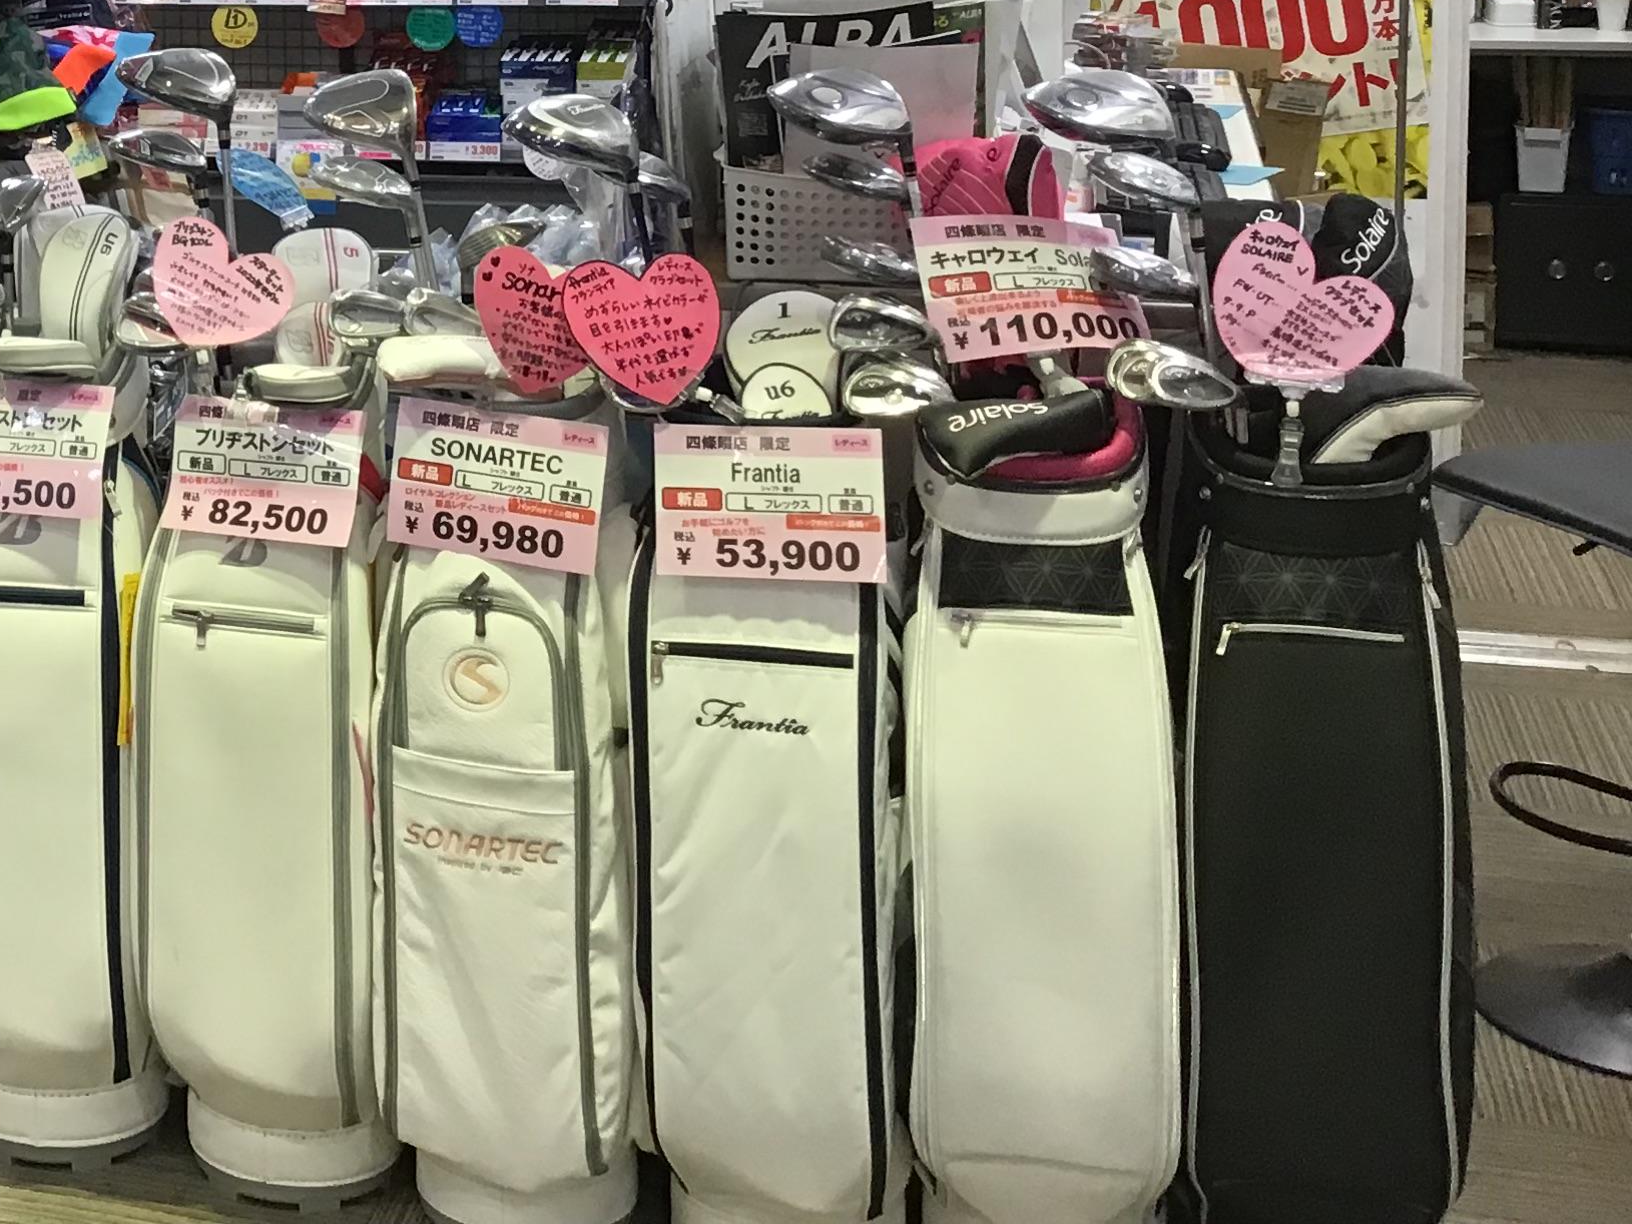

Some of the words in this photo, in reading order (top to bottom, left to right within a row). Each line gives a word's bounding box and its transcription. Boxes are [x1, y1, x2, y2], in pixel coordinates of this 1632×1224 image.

[1015, 223, 1046, 239] 限定
[1340, 207, 1390, 275] Solaire
[930, 246, 1040, 270] キャロウェイ
[1240, 243, 1296, 264] SOLAIRE
[943, 276, 978, 293] 新品
[1012, 275, 1023, 289] L
[1033, 276, 1076, 287] フレックス
[777, 302, 792, 319] 1
[954, 331, 969, 350] ¥
[979, 311, 1141, 347] 110,000
[948, 400, 1049, 433] Solaire
[195, 428, 335, 456] ブリヂストンセット
[489, 420, 520, 438] 限定
[563, 431, 595, 445] レディース
[759, 436, 791, 452] 限定
[833, 438, 869, 448] レディース
[8, 440, 46, 453] フレックス
[68, 444, 89, 457] 普通
[430, 437, 563, 475] SONARTEC
[189, 456, 214, 471] 新品
[243, 464, 251, 477] L
[259, 466, 298, 479] フレックス
[321, 469, 342, 483] 普通
[730, 462, 801, 484] Frantia
[182, 491, 200, 502] 税込
[410, 464, 440, 482] 新品
[462, 474, 471, 488] L
[491, 480, 533, 496] フレックス
[559, 489, 582, 505] 普通
[404, 499, 424, 514] 税込
[676, 490, 709, 508] 新品
[743, 496, 754, 511] L
[763, 498, 811, 511] フレックス
[838, 498, 864, 512] 普通
[180, 505, 194, 522] ¥
[208, 498, 328, 535] 82,500
[405, 515, 419, 534] ¥
[432, 511, 564, 559] 69,980
[673, 530, 696, 543] 税込
[676, 547, 692, 566] ¥
[715, 537, 861, 576] 53,900
[695, 698, 811, 735] Frantia
[403, 822, 565, 865] SONARTEC
